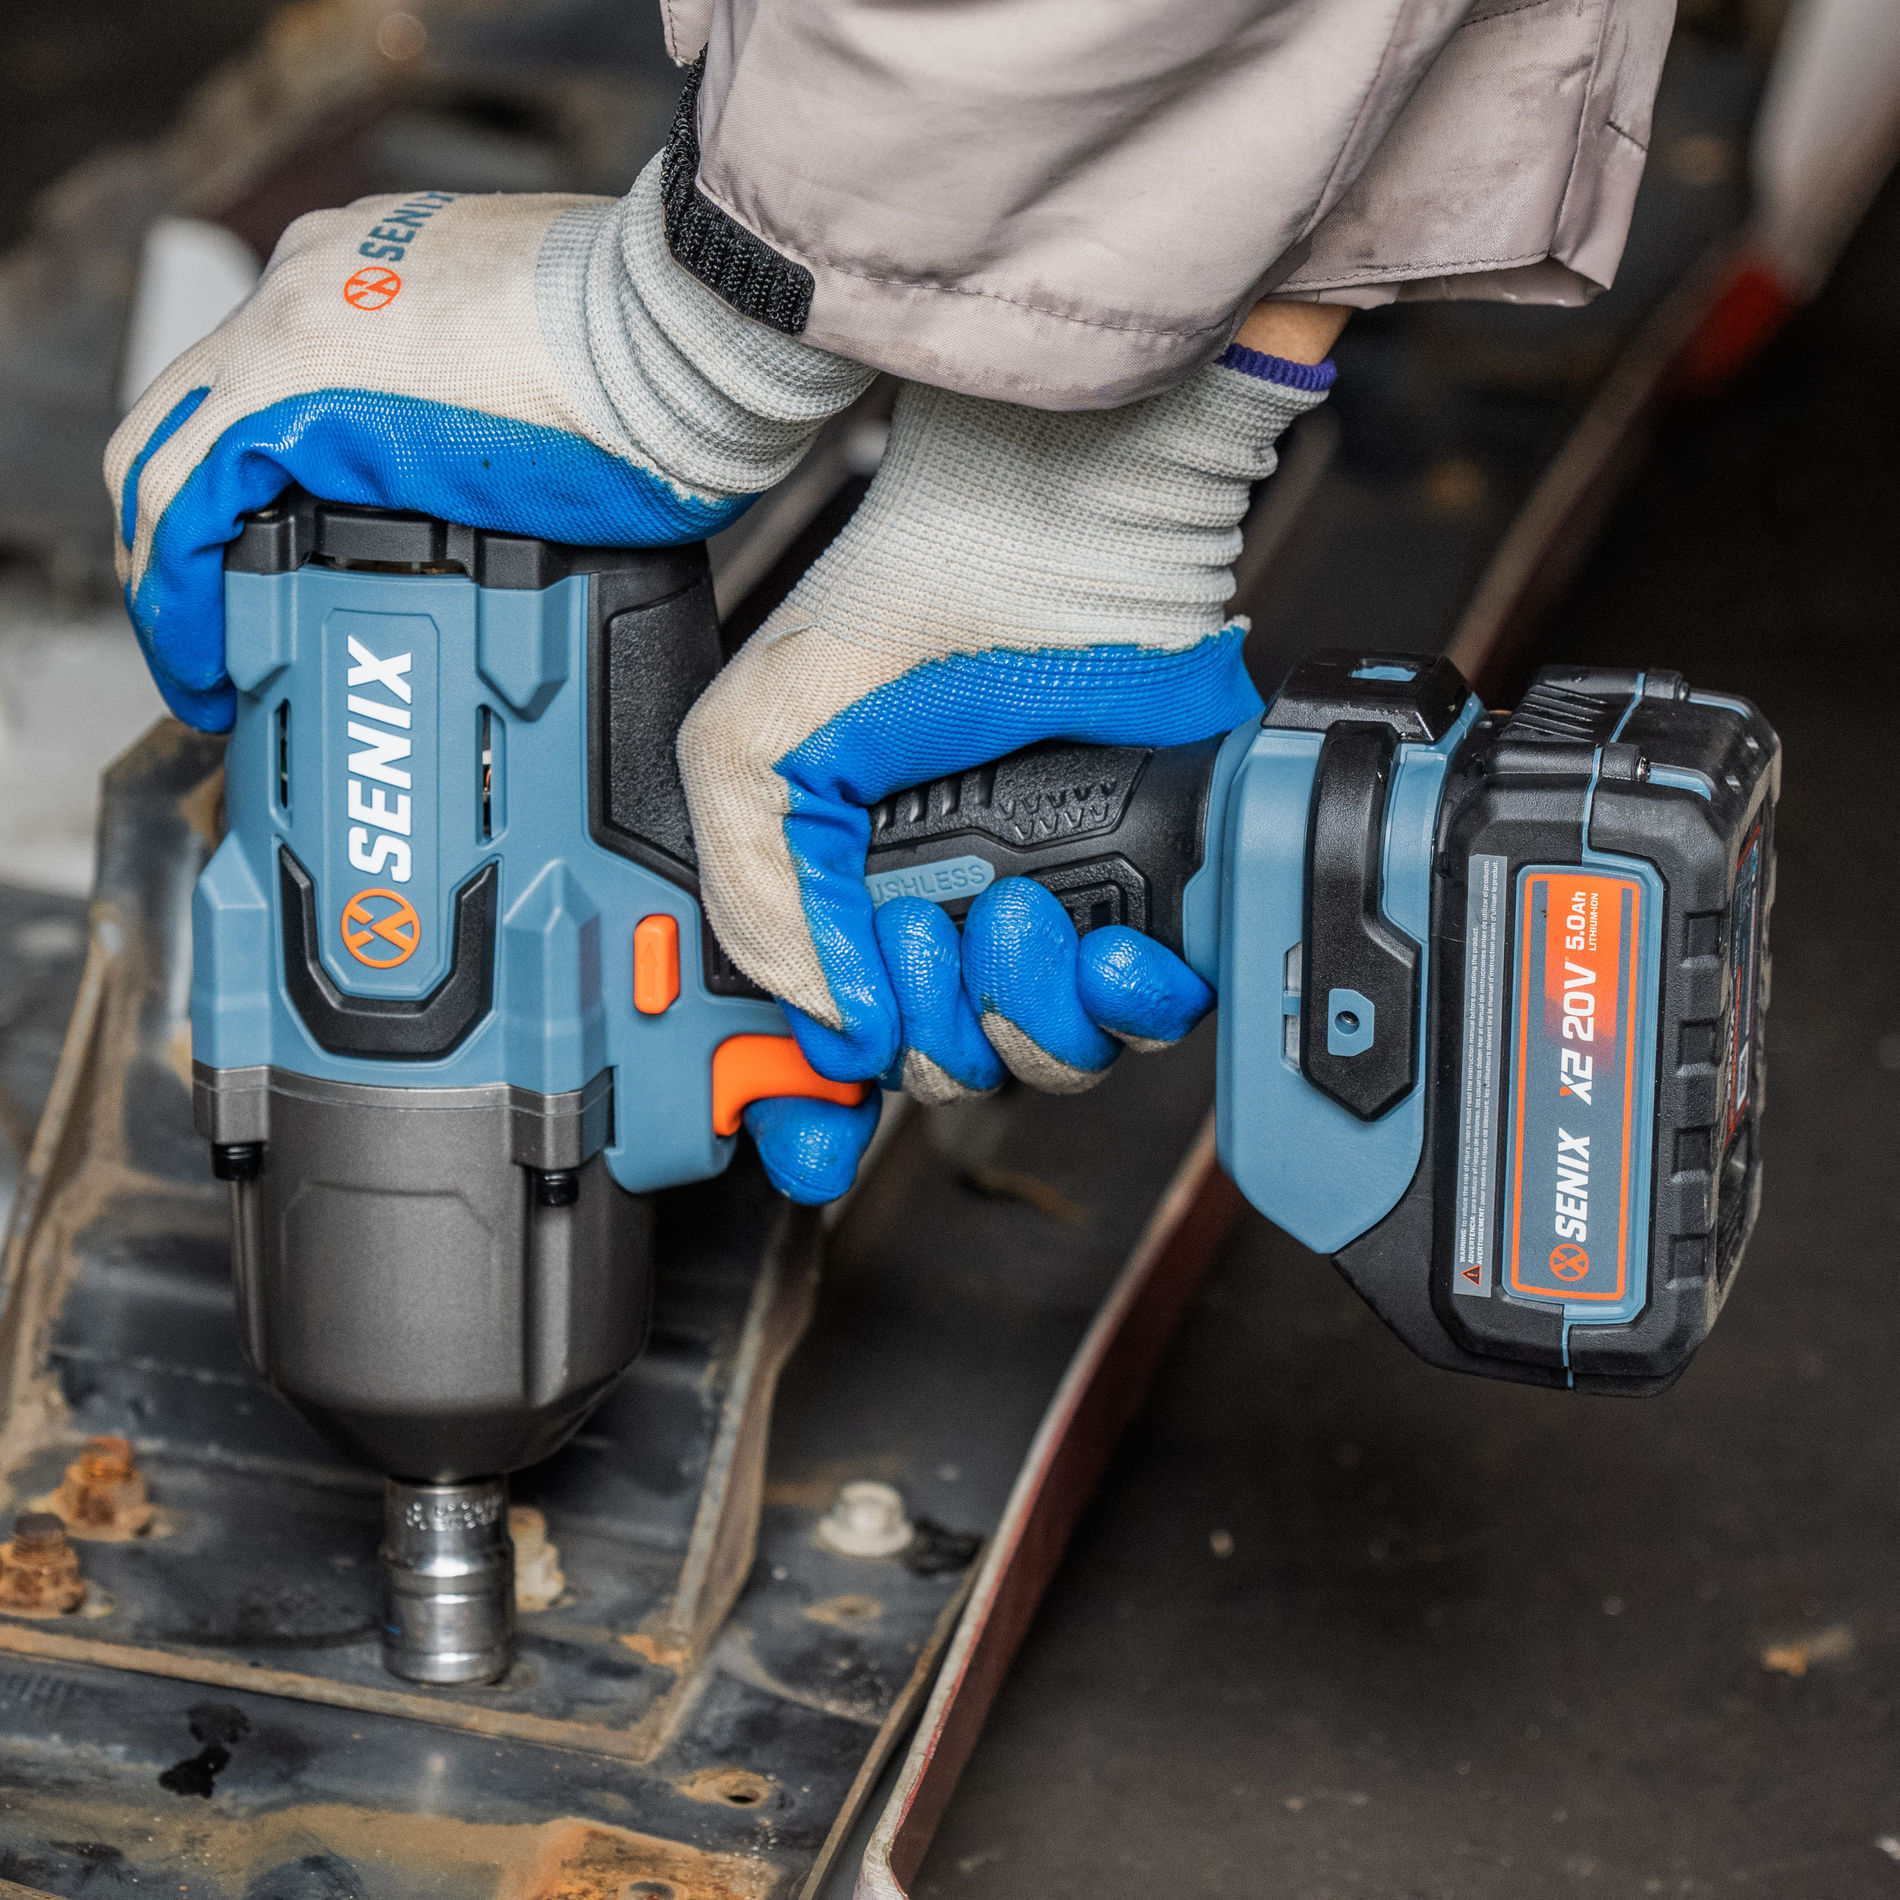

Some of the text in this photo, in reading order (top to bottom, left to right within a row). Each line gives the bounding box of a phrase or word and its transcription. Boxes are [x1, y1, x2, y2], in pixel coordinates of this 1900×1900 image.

[347, 634, 412, 884] SENIX
[1491, 860, 1499, 886] produit.
[1481, 921, 1488, 929] de
[1589, 892, 1599, 952] LITHIUM-ION
[1471, 926, 1479, 953] product.
[1470, 966, 1478, 997] operating
[1479, 950, 1487, 993] instrucciones
[1478, 994, 1485, 1003] de
[1484, 1052, 1492, 1088] utilisateurs
[1554, 891, 1597, 1243] SENIX X2 20V 5.0Ah
[1473, 1138, 1479, 1147] de
[1481, 1138, 1489, 1158] risque
[1482, 1129, 1489, 1137] de
[1472, 1147, 1480, 1168] riesgo
[1459, 1228, 1467, 1263] WARNING:
[1468, 1214, 1476, 1264] ADVERTENCIA:
[1476, 1206, 1485, 1265] AVERTISSEMENT:
